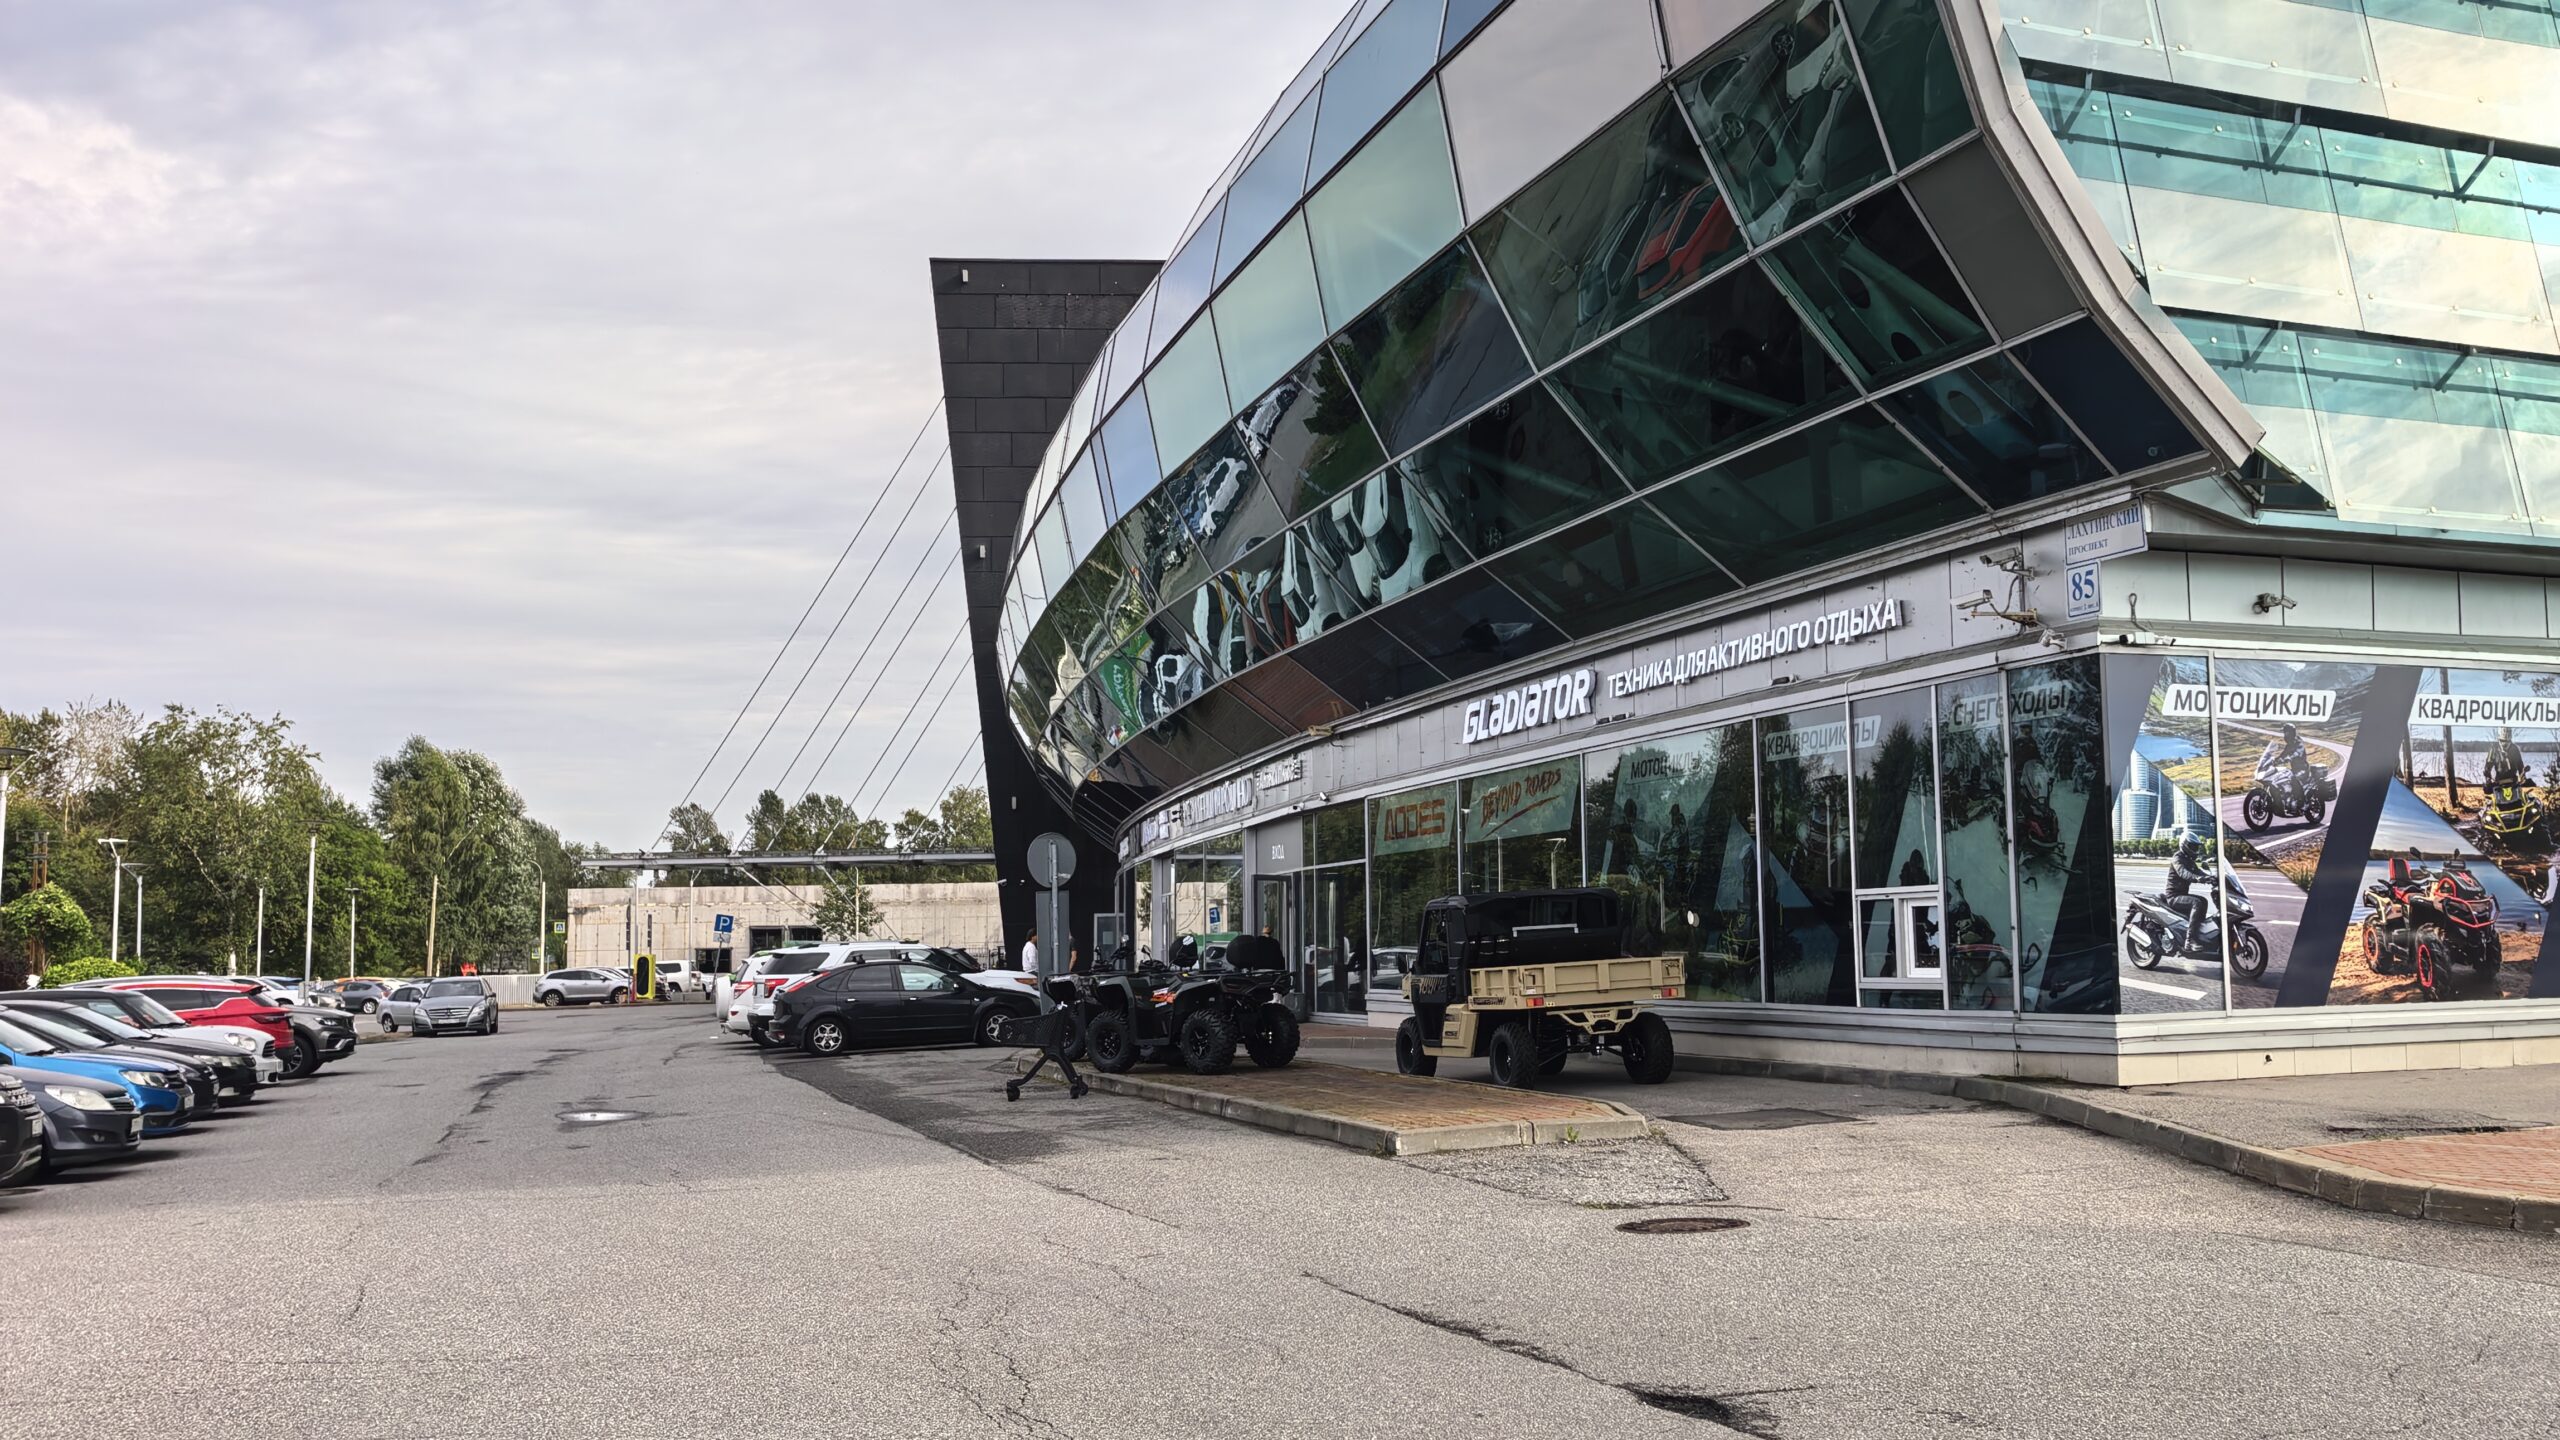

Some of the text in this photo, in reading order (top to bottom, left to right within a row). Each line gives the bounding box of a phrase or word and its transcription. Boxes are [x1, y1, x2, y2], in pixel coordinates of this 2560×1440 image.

[2067, 504, 2140, 540] ЛАХТИНСКИЙ
[2069, 539, 2108, 556] ПРОСПЕКТ
[2072, 569, 2095, 601] 85
[1607, 599, 1896, 698] ТЕХНИКА ДЛЯ АКТИВНОГО ОТДЫХА
[2174, 689, 2327, 718] МОТОЦИКЛЫ
[2418, 697, 2560, 724] КВАДРОЦИКЛЫ
[719, 916, 730, 930] P
